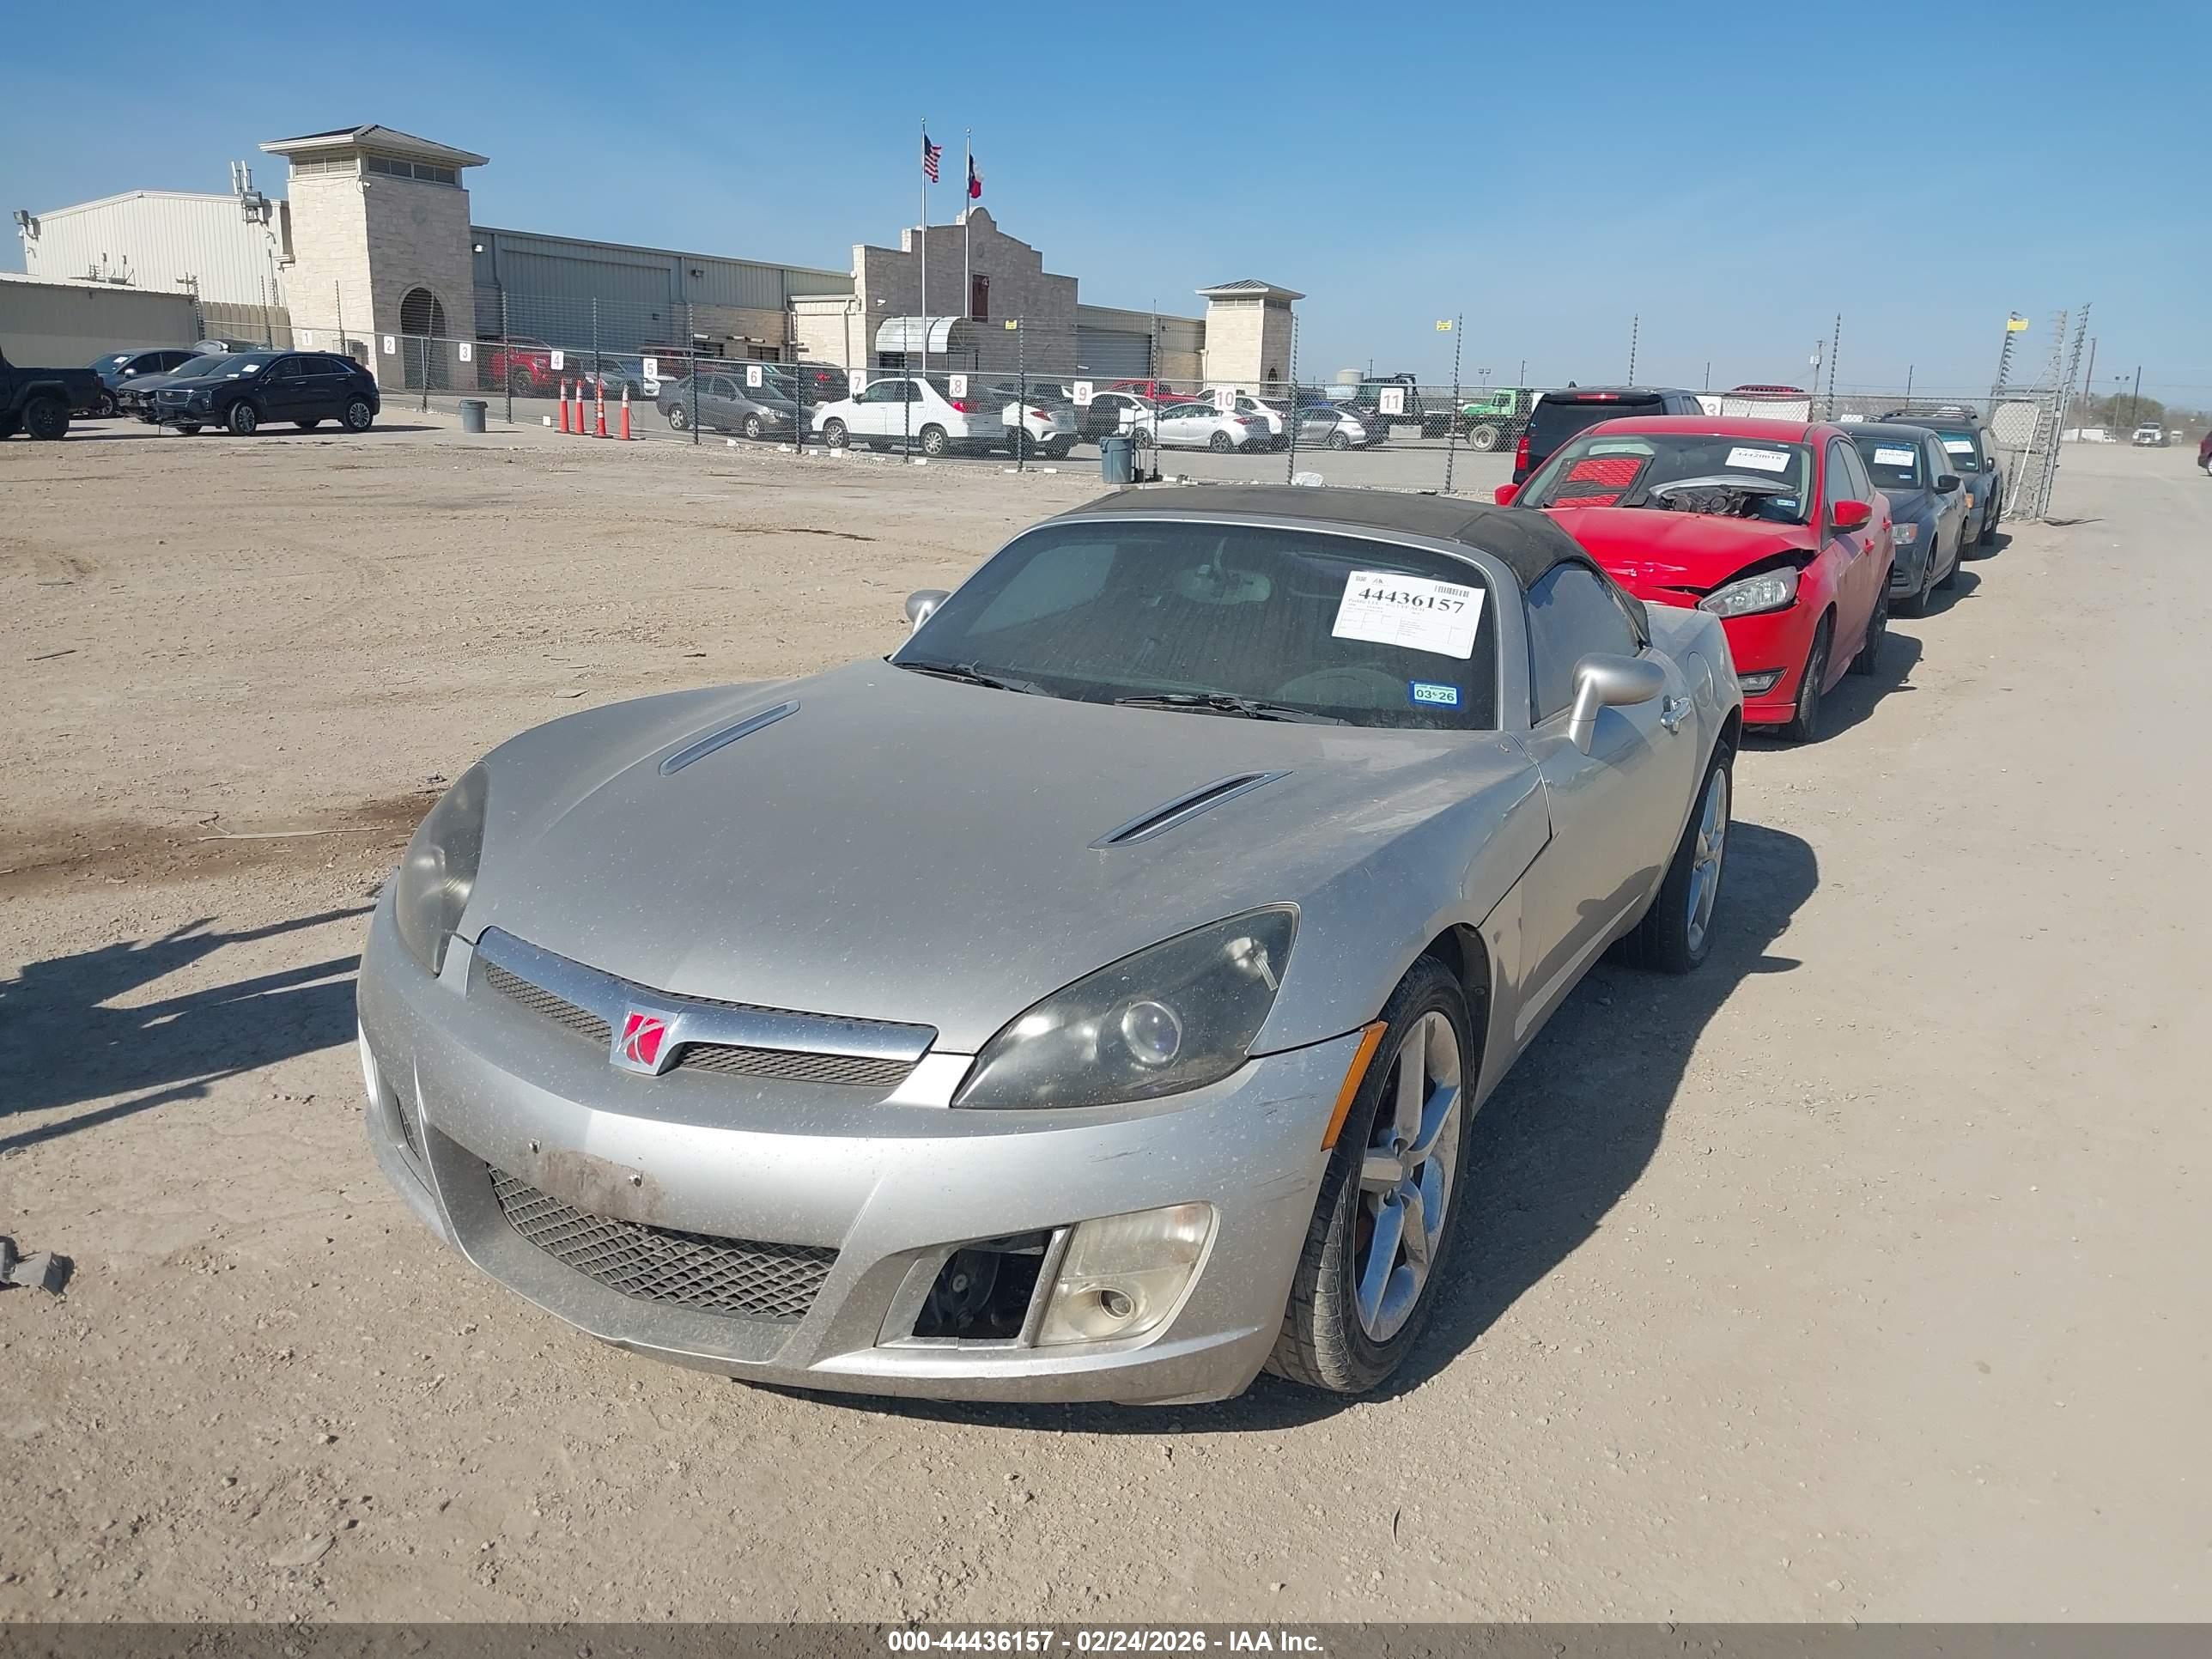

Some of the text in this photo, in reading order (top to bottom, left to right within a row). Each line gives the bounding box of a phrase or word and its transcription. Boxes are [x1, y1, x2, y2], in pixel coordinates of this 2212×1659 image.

[386, 341, 393, 351] 2
[462, 347, 469, 358] 3
[554, 355, 560, 367] 4
[647, 362, 653, 374] 5
[750, 371, 757, 383] 6
[854, 377, 861, 391] 7
[955, 380, 963, 394] 8
[1079, 387, 1087, 401] 9
[1217, 392, 1234, 407] 10
[1383, 395, 1400, 410] 11
[1358, 587, 1465, 615] 44436157
[1416, 689, 1455, 702] 03 26
